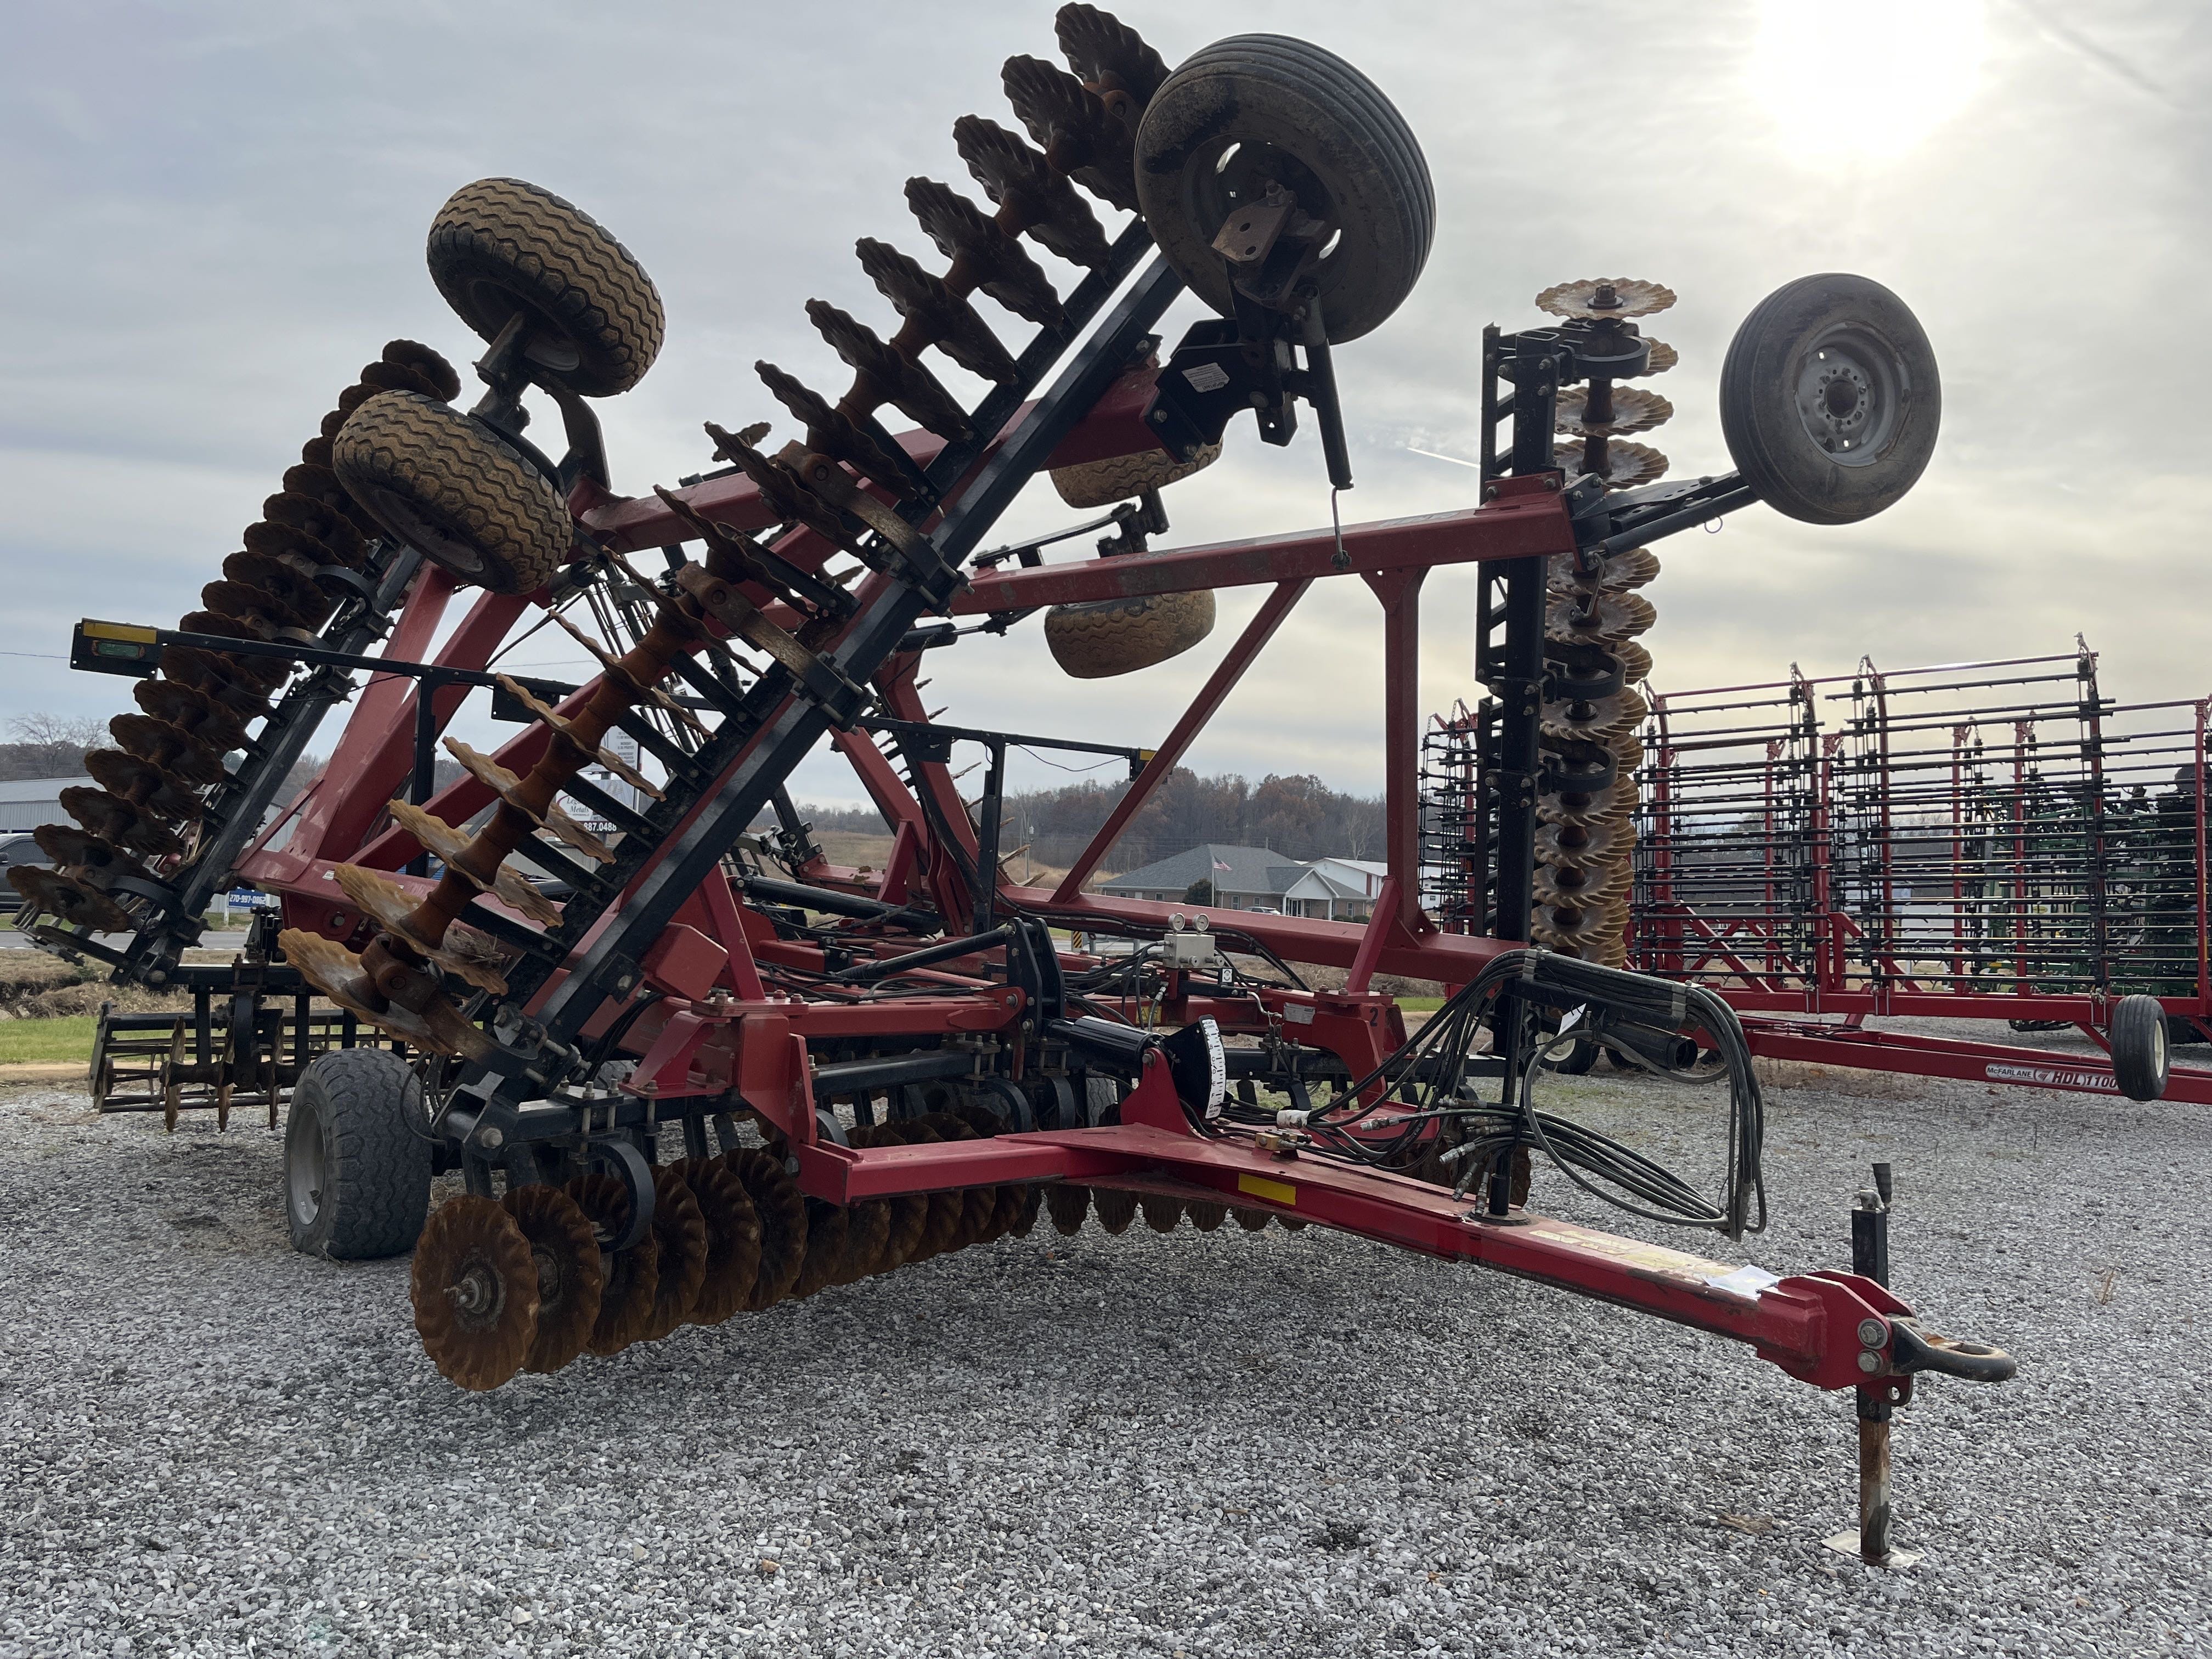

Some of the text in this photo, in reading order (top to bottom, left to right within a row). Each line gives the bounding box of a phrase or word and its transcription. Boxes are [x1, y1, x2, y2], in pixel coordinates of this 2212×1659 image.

[1369, 1007, 1378, 1027] 2
[1987, 1067, 2033, 1078] McFARLANE
[2051, 1070, 2081, 1085] HDL
